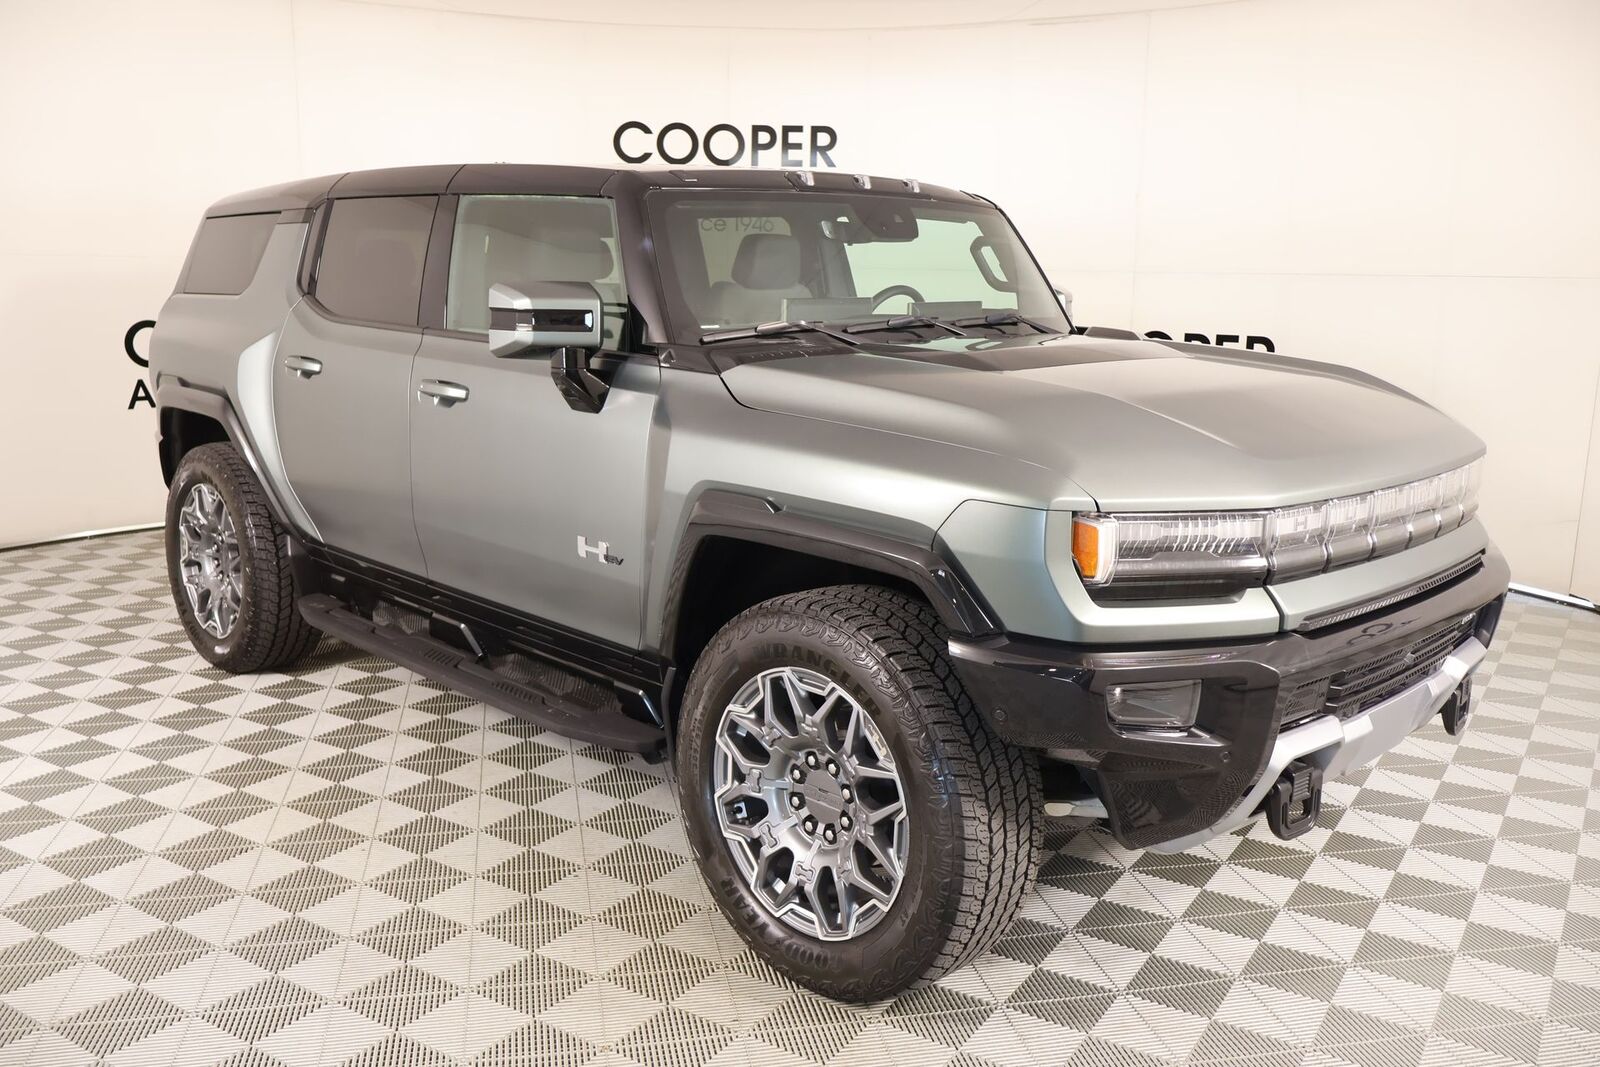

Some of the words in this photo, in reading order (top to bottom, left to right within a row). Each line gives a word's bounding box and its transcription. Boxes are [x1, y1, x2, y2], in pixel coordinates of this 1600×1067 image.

[612, 121, 838, 168] COOPER
[735, 216, 775, 233] 1946
[752, 641, 881, 716] WRANGLER
